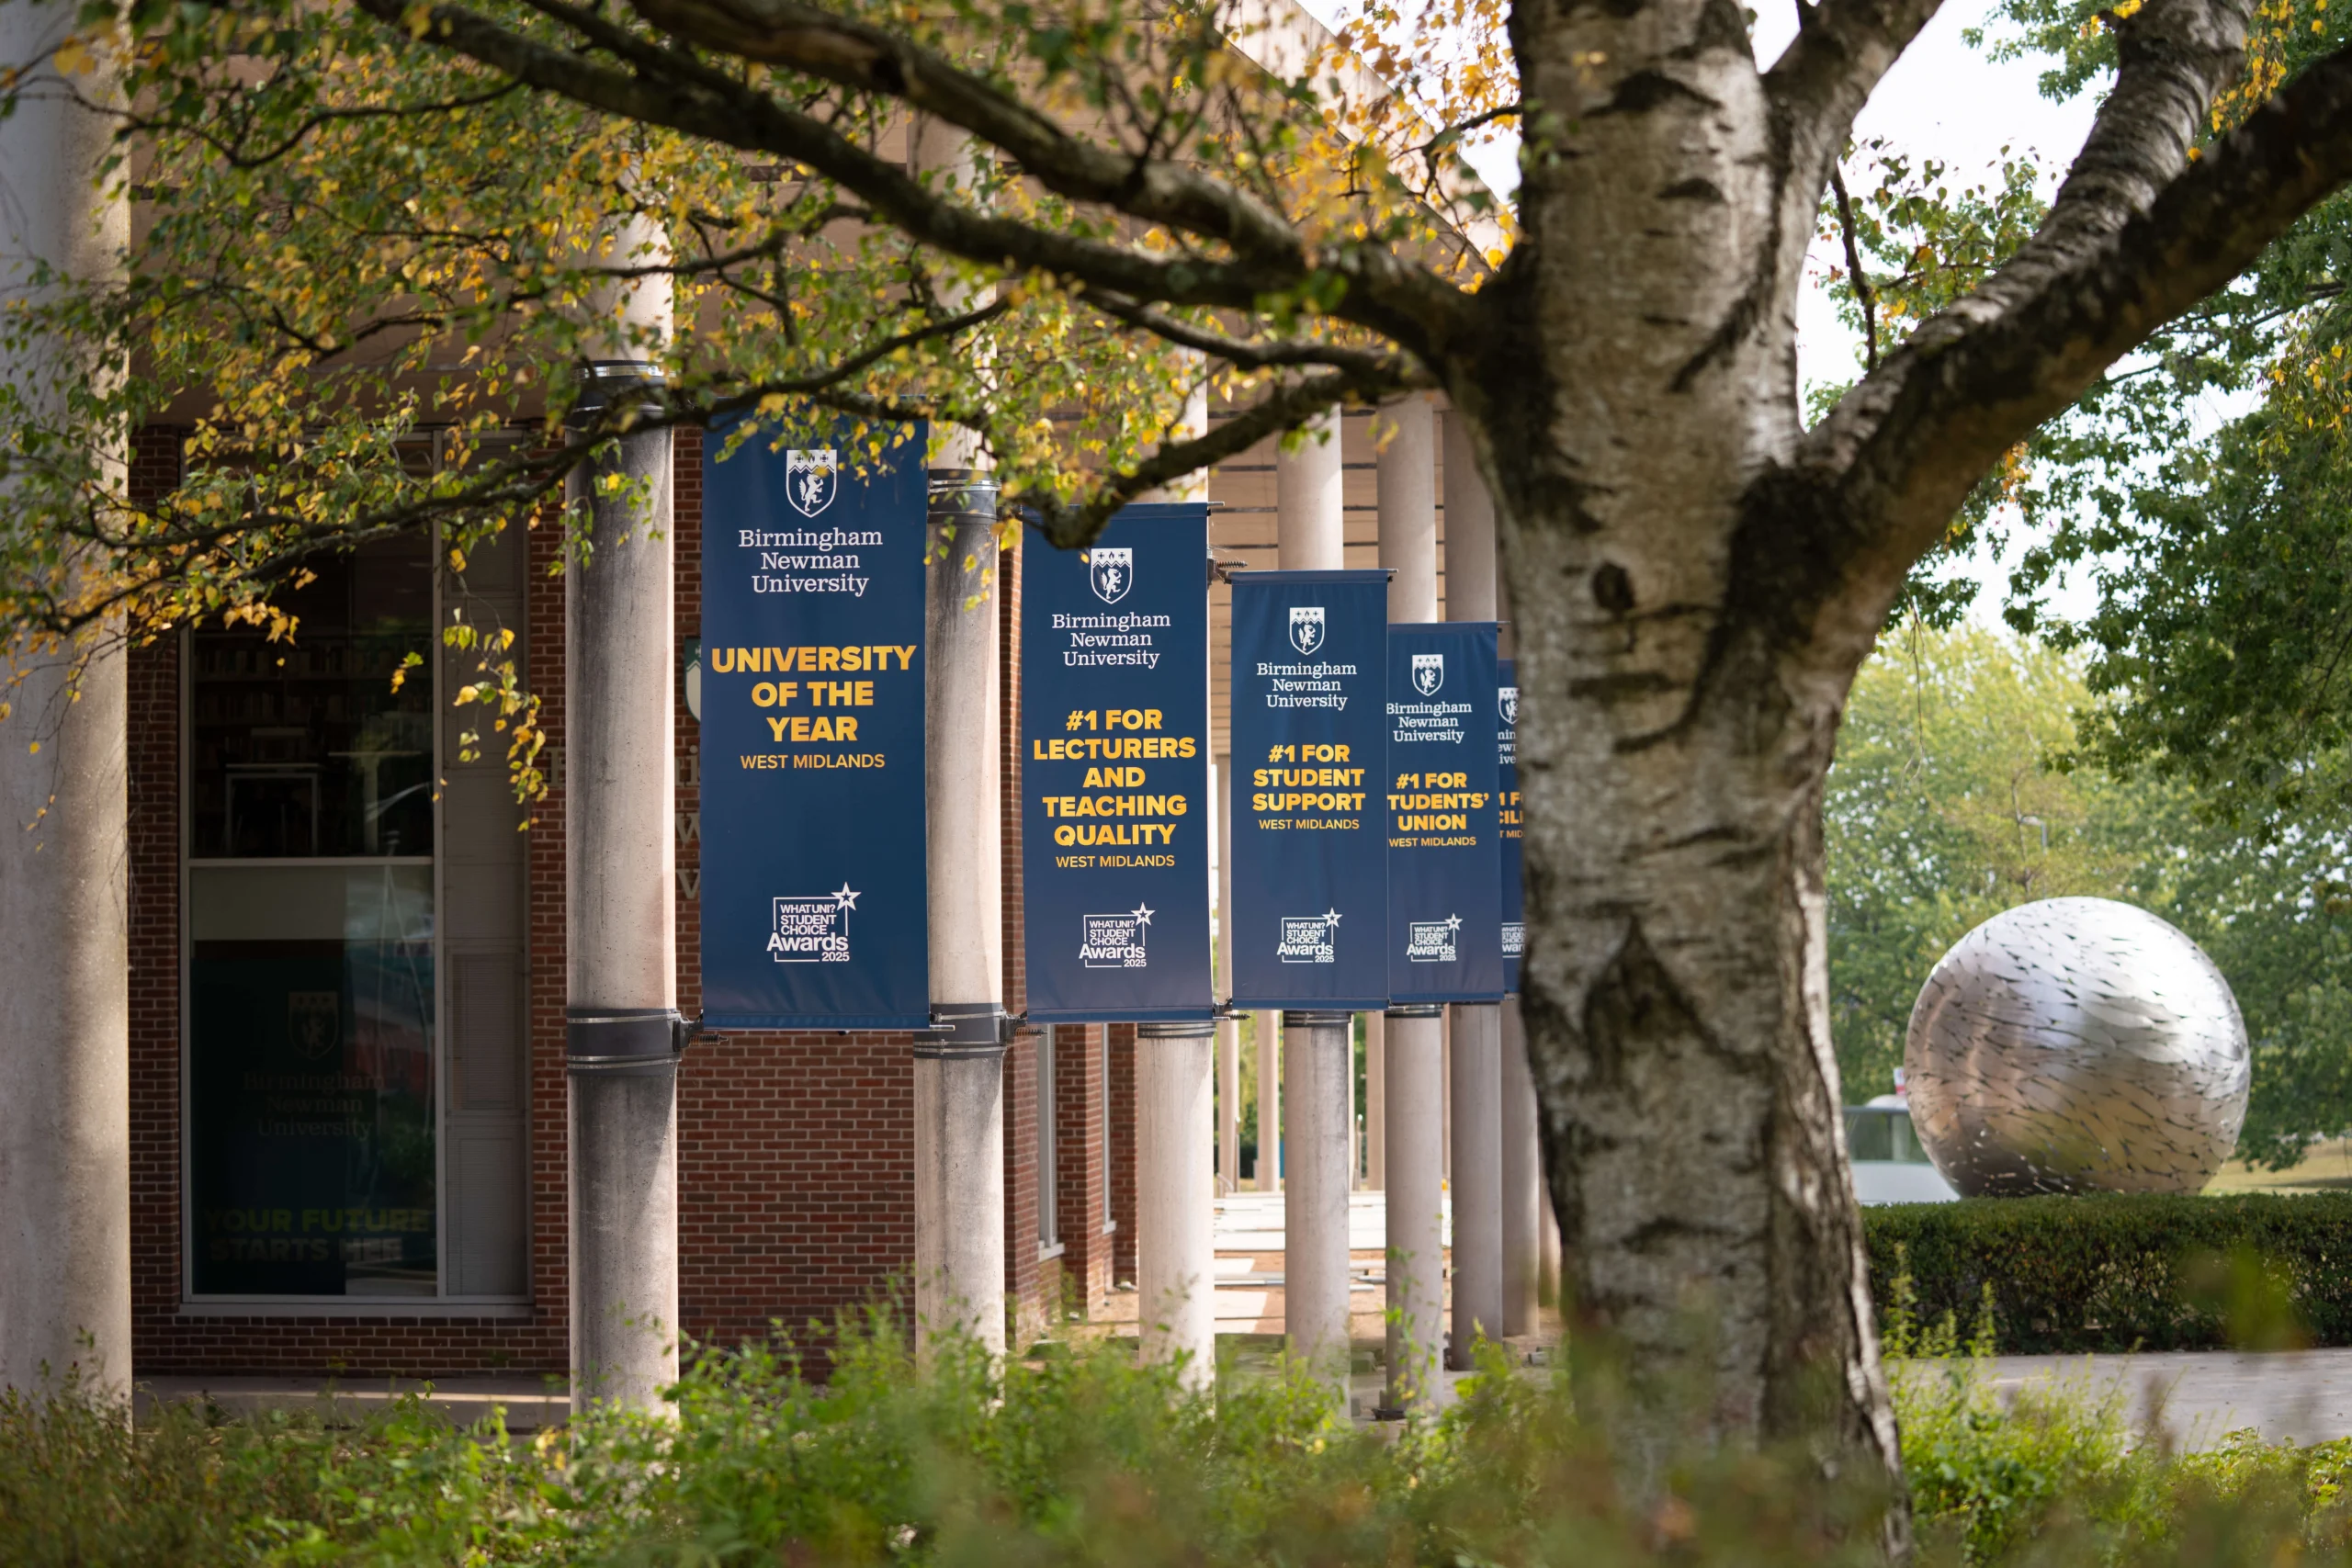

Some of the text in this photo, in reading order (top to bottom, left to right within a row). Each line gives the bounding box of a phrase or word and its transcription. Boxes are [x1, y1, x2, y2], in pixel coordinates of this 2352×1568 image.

[739, 527, 882, 551] Birmingham
[761, 552, 860, 570] Newman
[752, 573, 869, 596] University
[1052, 612, 1170, 631] Birmingham
[1070, 632, 1152, 647] Newman
[711, 645, 916, 672] UNIVERSITY
[1063, 650, 1159, 669] University
[1257, 661, 1357, 679] Birmingham
[1272, 679, 1341, 691] Newman
[752, 681, 873, 707] OF THE
[1266, 694, 1348, 711] University
[1386, 702, 1472, 716] Birmingham
[766, 716, 858, 741] YEAR
[1066, 709, 1162, 731] #1 FOR
[1398, 716, 1459, 728] Newman
[1393, 729, 1464, 744] University
[1035, 737, 1196, 760] LECTURERS
[1268, 744, 1350, 762] #1 FOR
[741, 754, 885, 769] WEST MIDLANDS
[1083, 767, 1145, 787] AND
[1253, 769, 1364, 787] STUDENT
[1396, 773, 1467, 789] #1 FOR
[1042, 795, 1187, 818] TEACHING
[1252, 793, 1365, 811] SUPPORT
[1387, 793, 1489, 810] TUDENTS’
[1259, 819, 1360, 829] WEST MIDLANDS
[1398, 814, 1466, 831] UNION
[1055, 824, 1176, 847] QUALITY
[1389, 837, 1476, 847] WEST MIDLANDS
[1056, 855, 1174, 867] WEST MIDLANDS
[780, 915, 837, 925] STUDENT
[781, 925, 827, 935] CHOICE
[1090, 929, 1136, 937] STUDENT
[766, 932, 849, 951] Awards
[1090, 937, 1127, 945] CHOICE
[1276, 942, 1334, 955] Awards
[1407, 943, 1455, 955] Awards
[821, 952, 850, 962] 2025
[1079, 943, 1145, 959] Awards
[1124, 959, 1147, 967] 2025
[243, 1071, 384, 1096] Birmingham
[265, 1096, 363, 1113] Newman
[257, 1116, 373, 1142] University
[204, 1208, 429, 1232] YOUR FUTURE
[209, 1238, 329, 1261] STARTS
